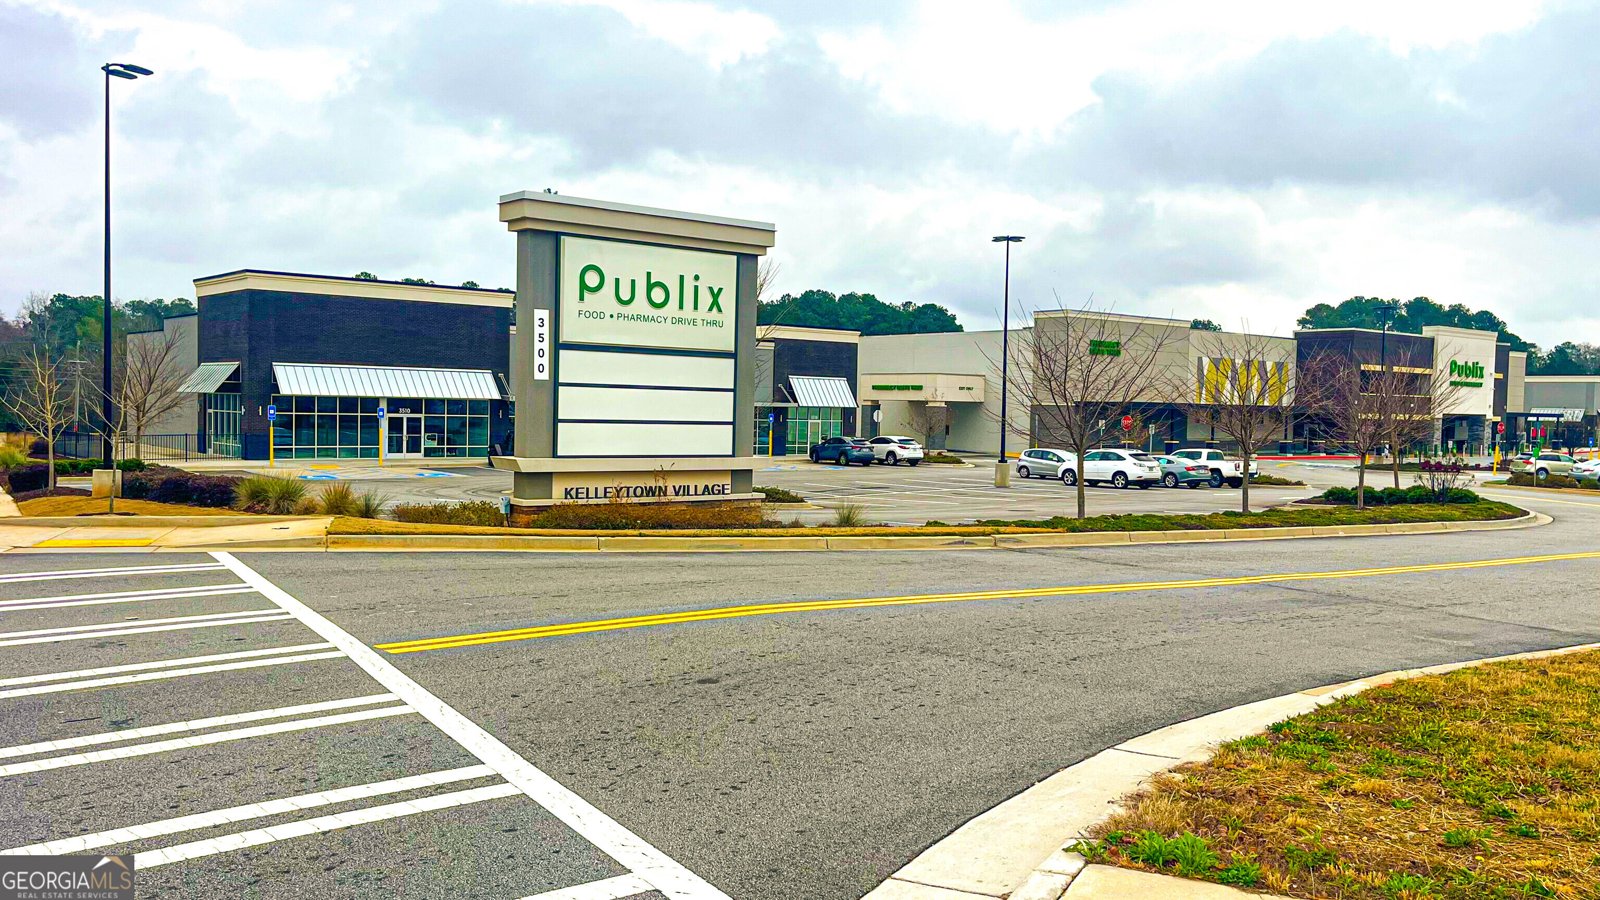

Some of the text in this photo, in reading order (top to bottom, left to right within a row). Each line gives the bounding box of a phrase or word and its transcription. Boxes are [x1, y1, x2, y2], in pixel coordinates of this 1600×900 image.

[578, 263, 724, 314] Publix
[577, 309, 724, 328] FOOD PHARMACY DRIVE THRU
[537, 317, 545, 373] 3500
[1449, 359, 1485, 379] Publix
[564, 483, 731, 500] KELLEYTOWN VILLAGE
